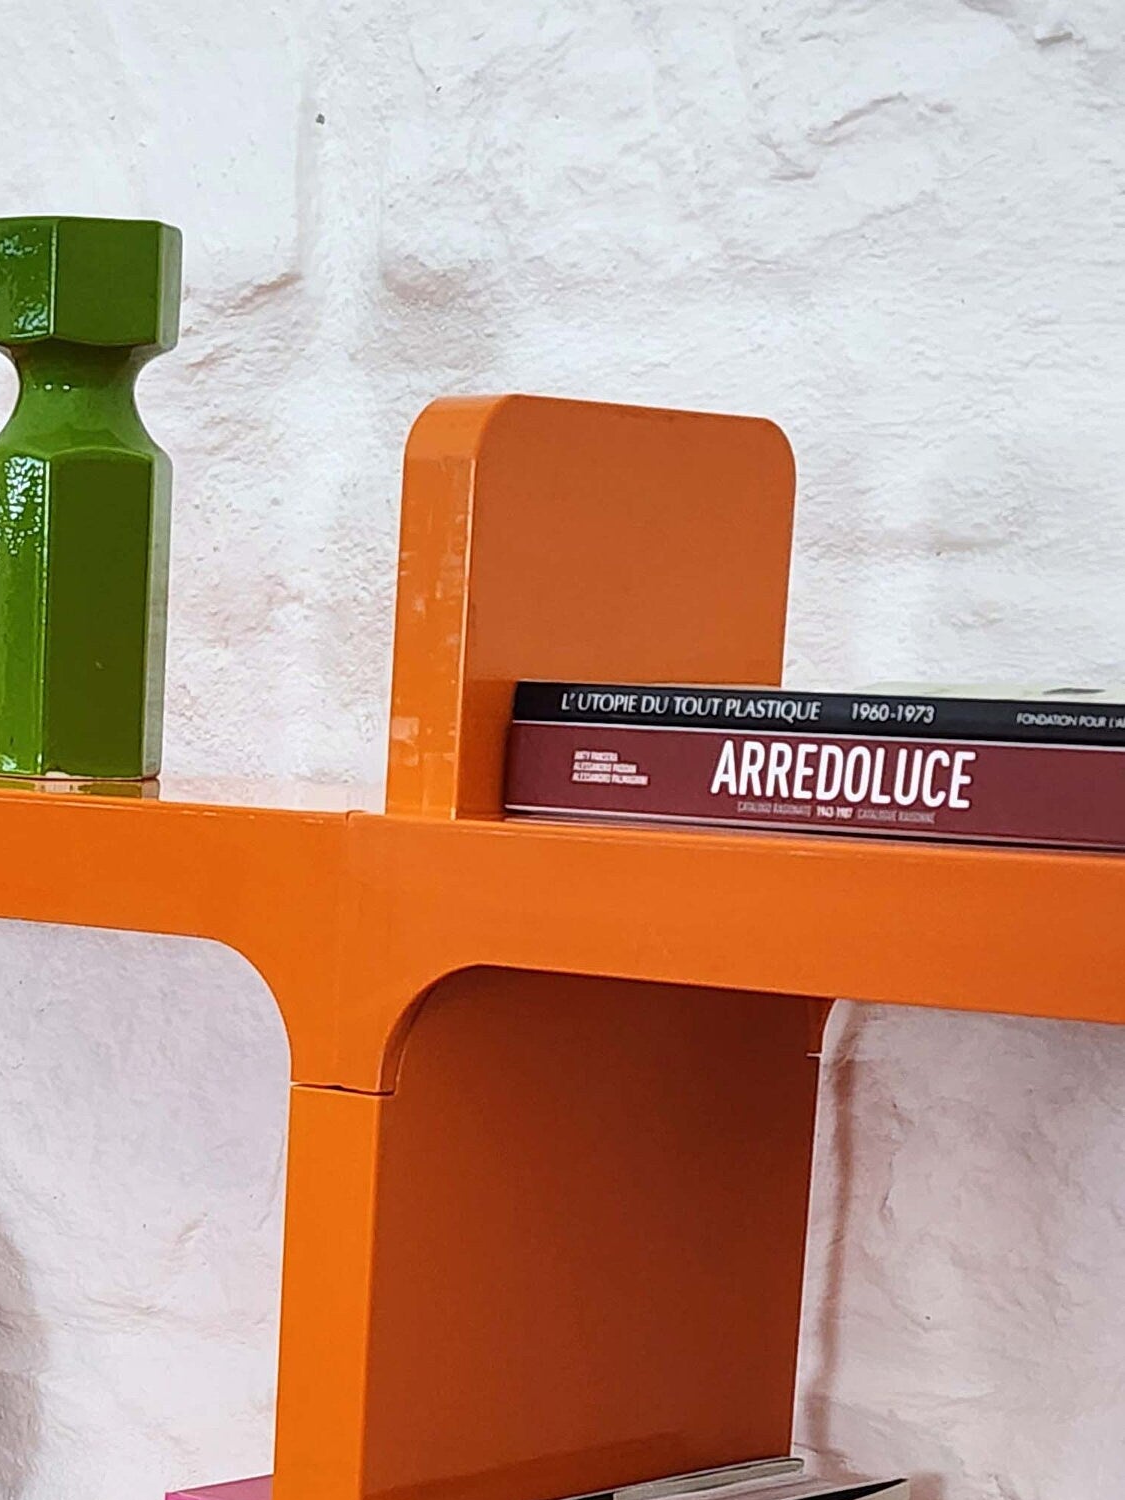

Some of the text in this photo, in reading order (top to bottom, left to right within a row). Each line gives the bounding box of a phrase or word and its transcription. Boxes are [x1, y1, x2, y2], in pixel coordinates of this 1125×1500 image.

[640, 696, 670, 714] DU
[674, 696, 723, 717] TOUT
[724, 698, 822, 723] PLASTIQUE
[850, 701, 936, 725] 1960-1973
[1016, 711, 1077, 727] FONDATION
[1078, 714, 1107, 728] POUR
[709, 738, 976, 809] ARREDOLUCE
